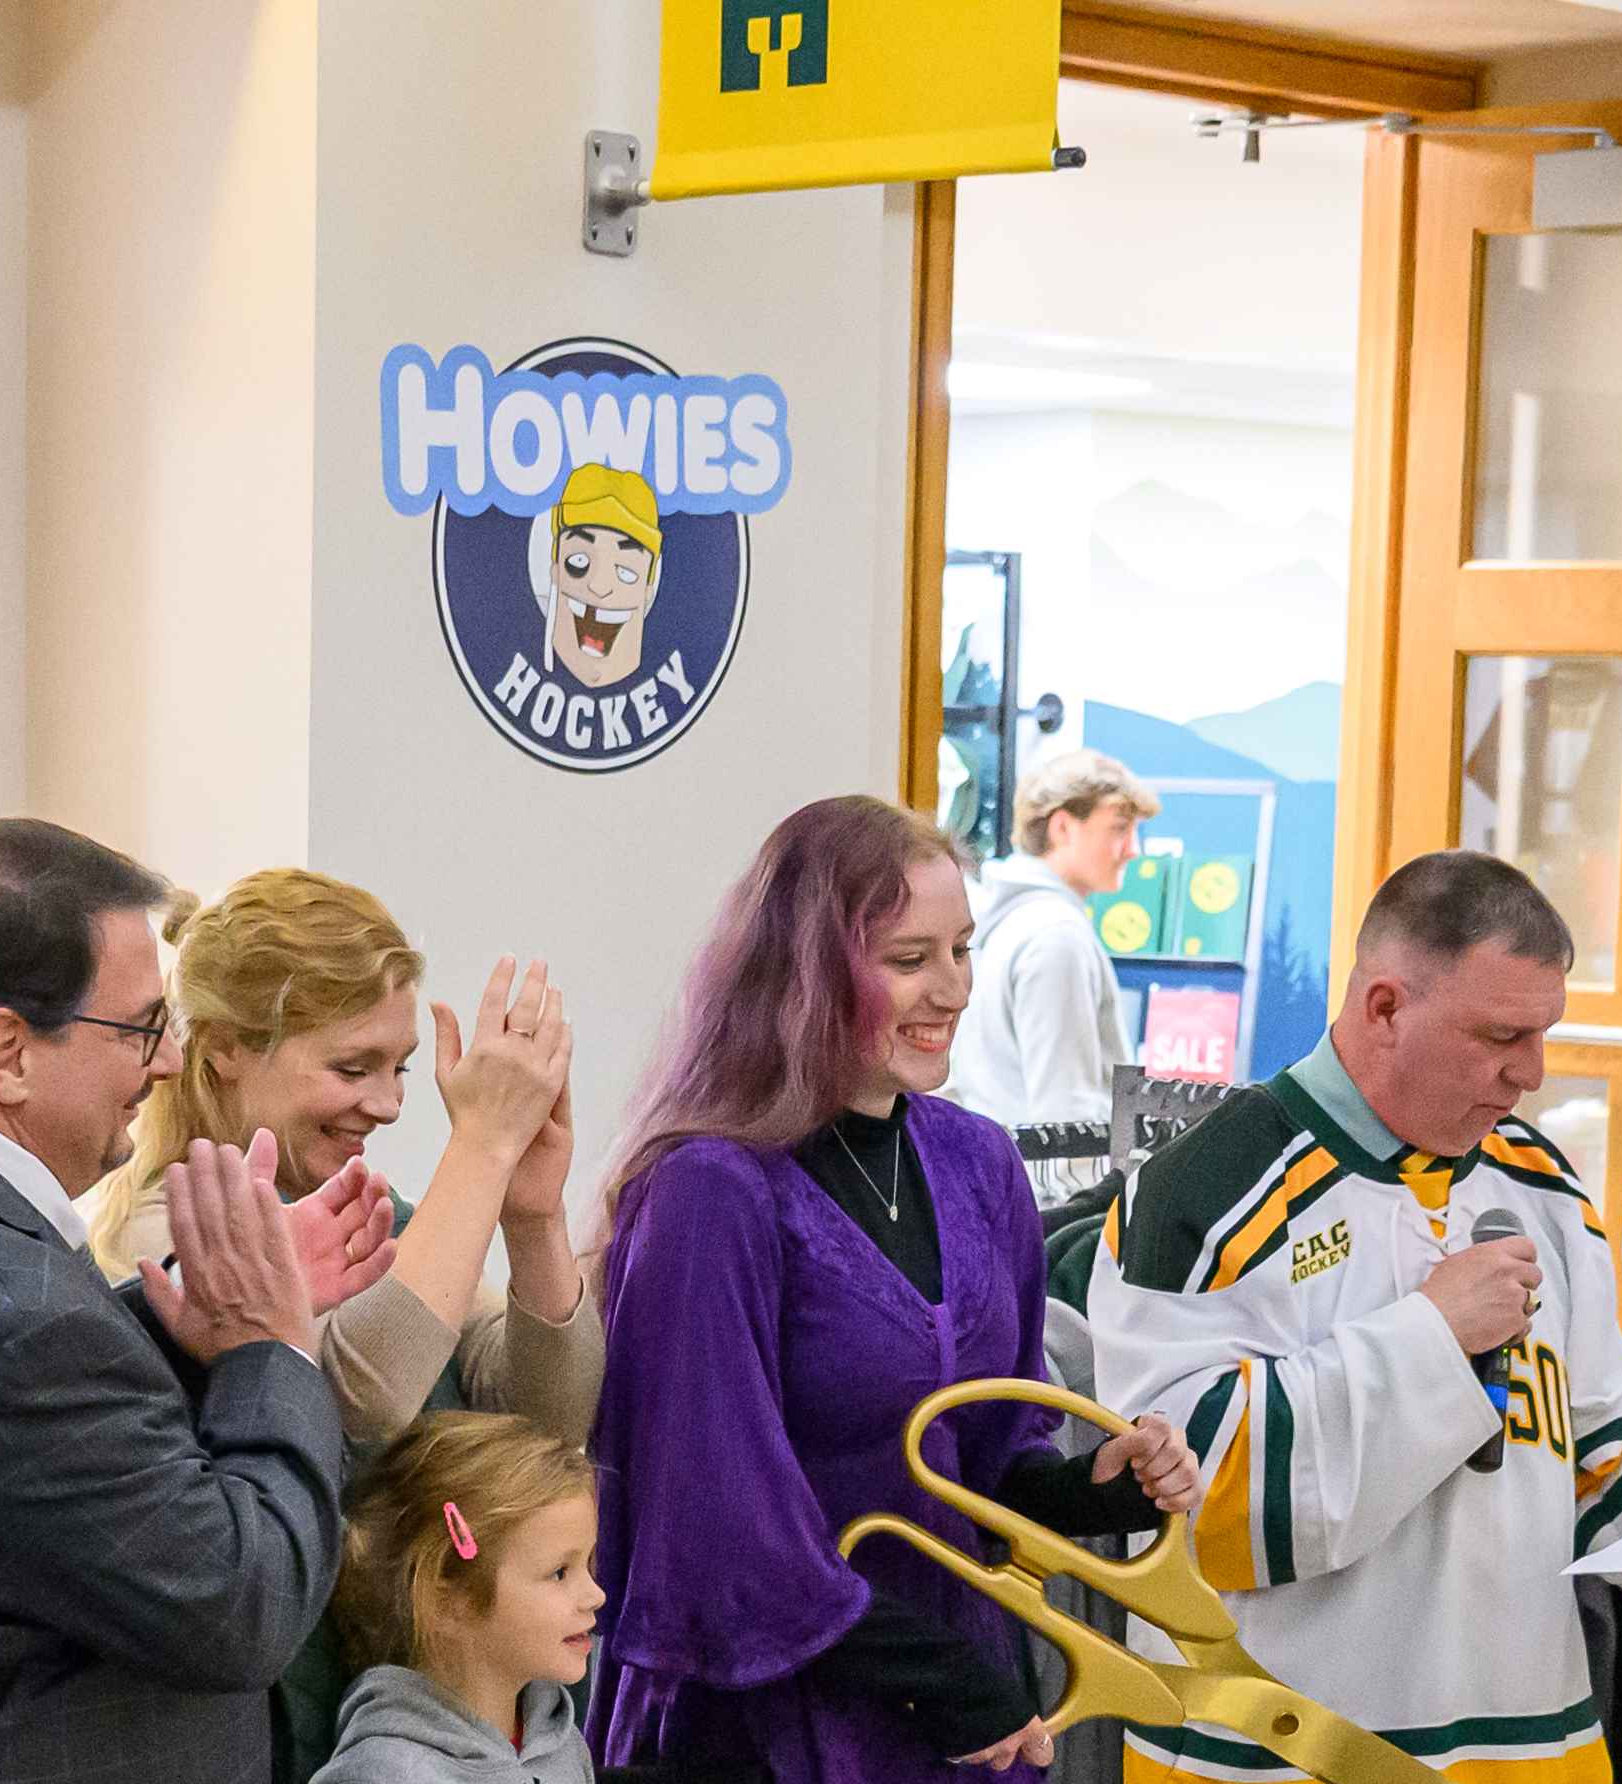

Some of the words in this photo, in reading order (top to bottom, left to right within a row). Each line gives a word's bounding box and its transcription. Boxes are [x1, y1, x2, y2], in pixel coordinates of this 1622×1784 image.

[393, 358, 783, 499] HOWIES
[493, 649, 695, 751] HOCKEY
[1152, 1034, 1226, 1073] SALE
